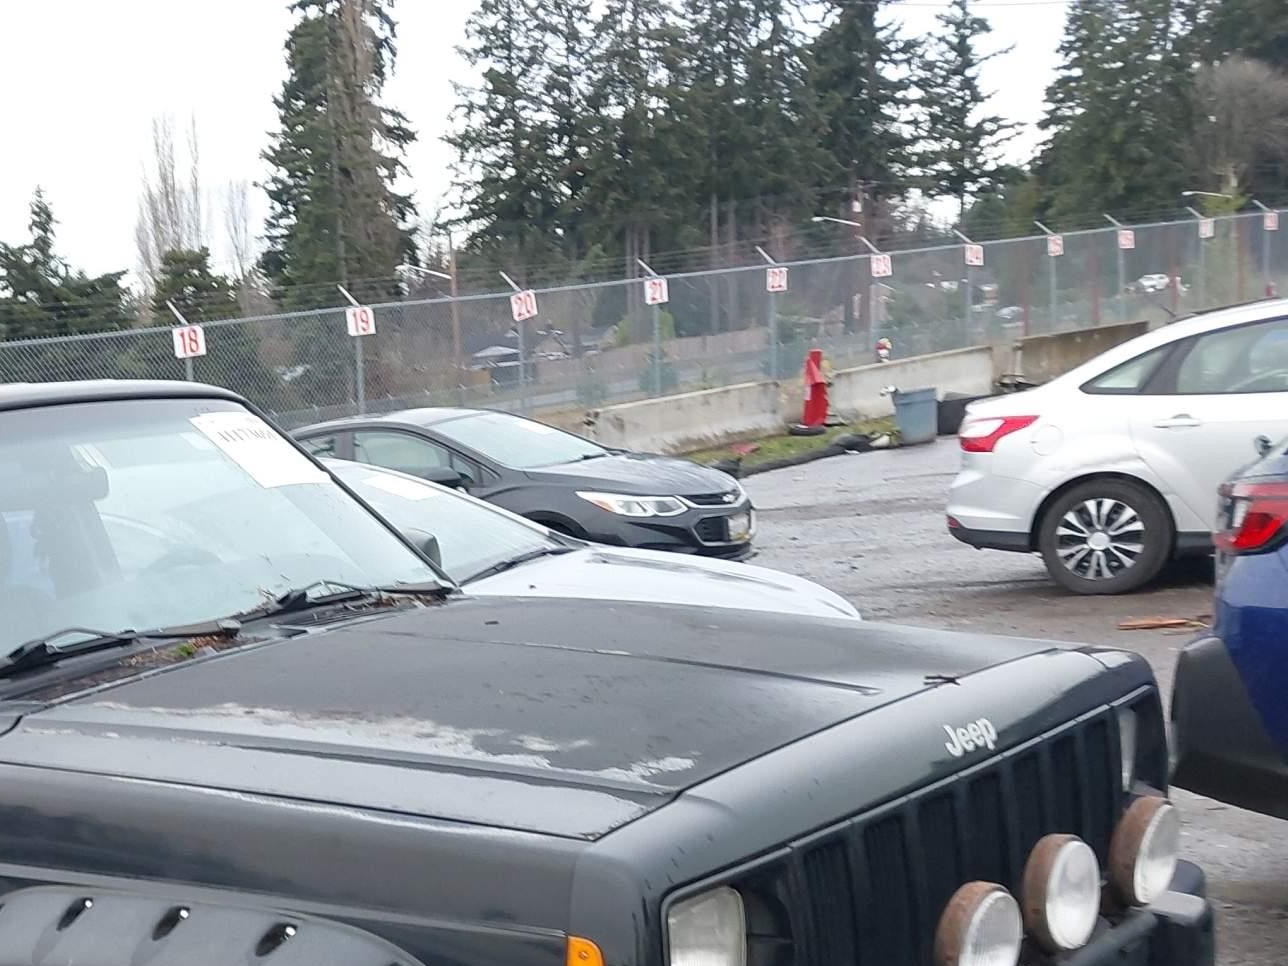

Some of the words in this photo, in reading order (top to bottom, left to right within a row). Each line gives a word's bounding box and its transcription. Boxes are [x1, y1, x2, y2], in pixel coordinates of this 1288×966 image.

[515, 293, 534, 317] 20
[352, 310, 369, 333] 19
[179, 328, 199, 356] 18
[943, 717, 998, 757] Jeep
